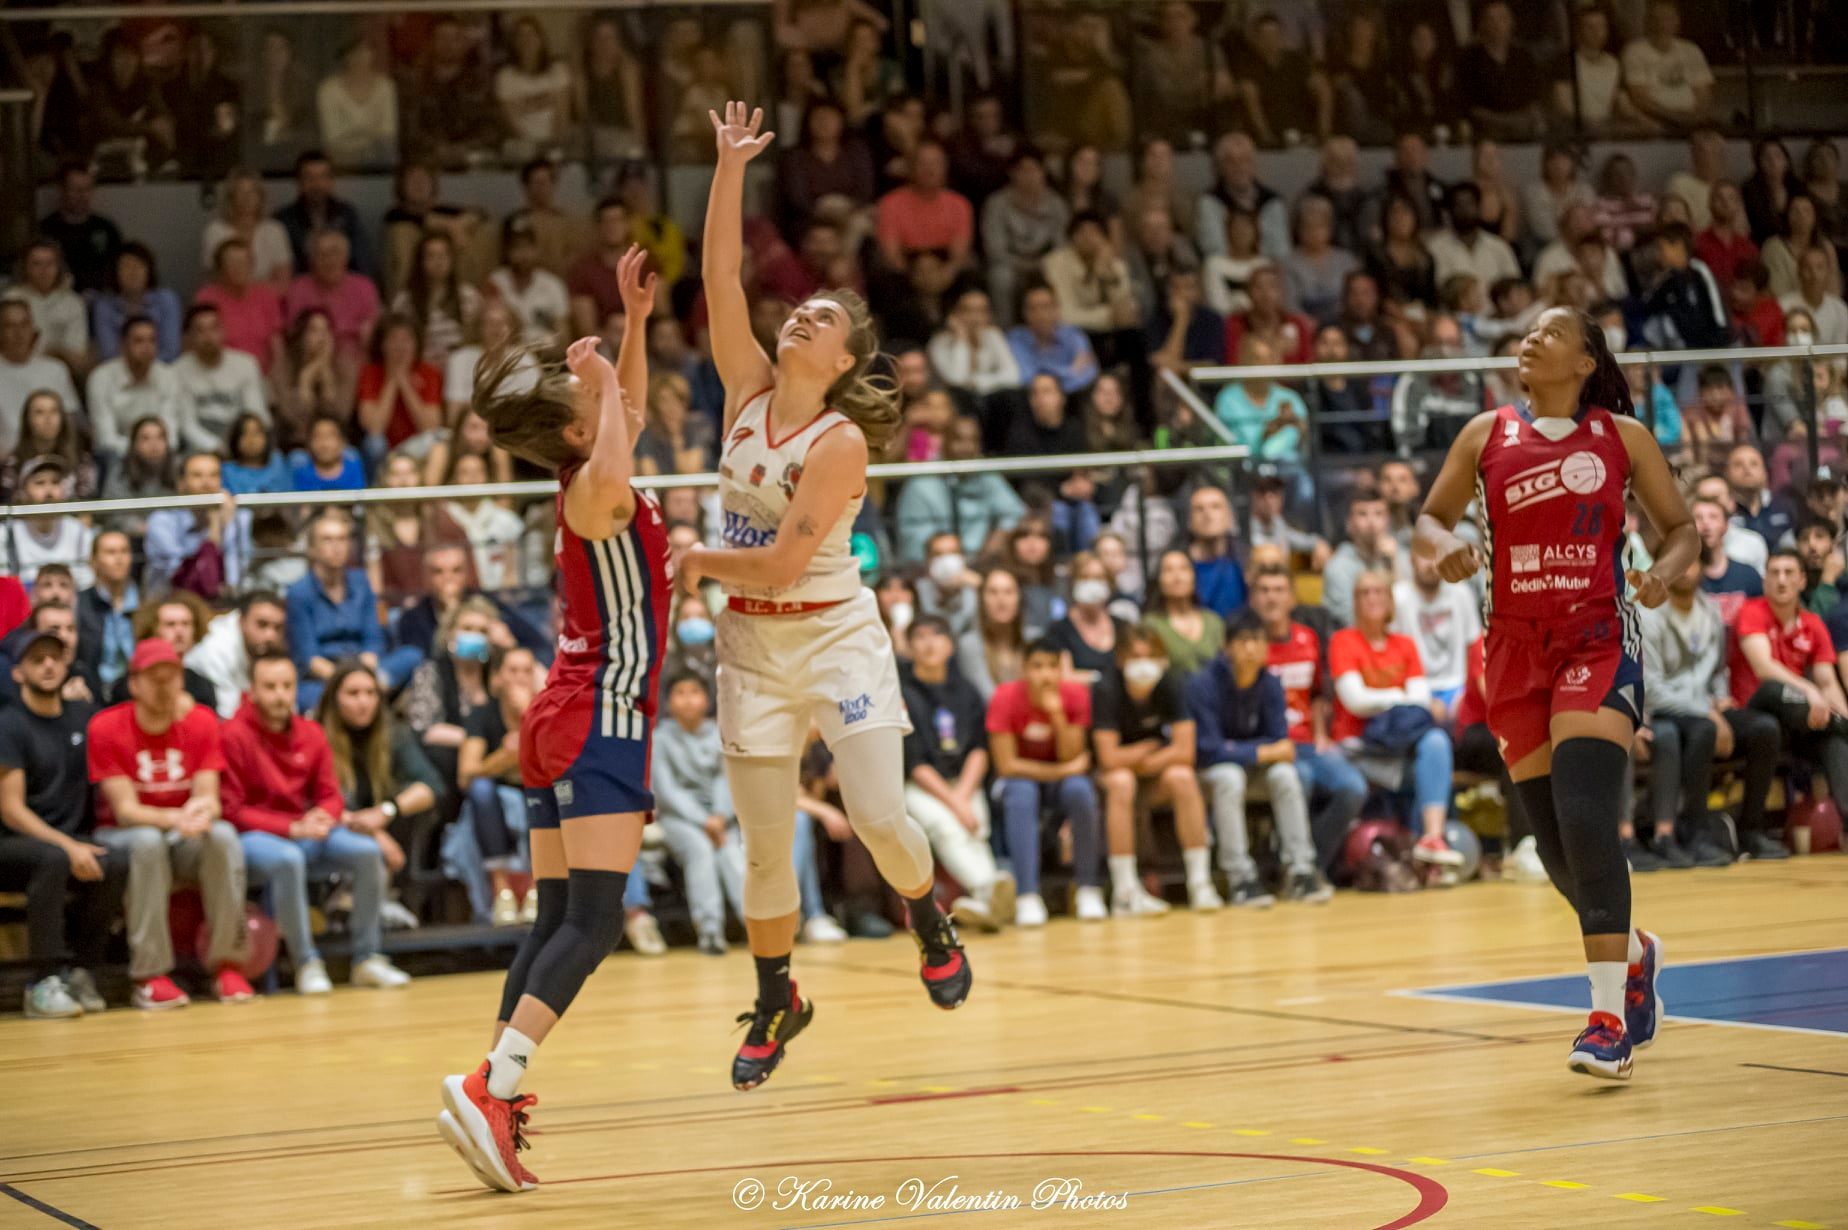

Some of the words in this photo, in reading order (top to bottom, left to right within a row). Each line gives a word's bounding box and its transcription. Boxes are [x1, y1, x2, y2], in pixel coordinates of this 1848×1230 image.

[723, 509, 777, 548] Wor
[1543, 543, 1596, 560] ALCYS
[1554, 574, 1591, 591] Mutue
